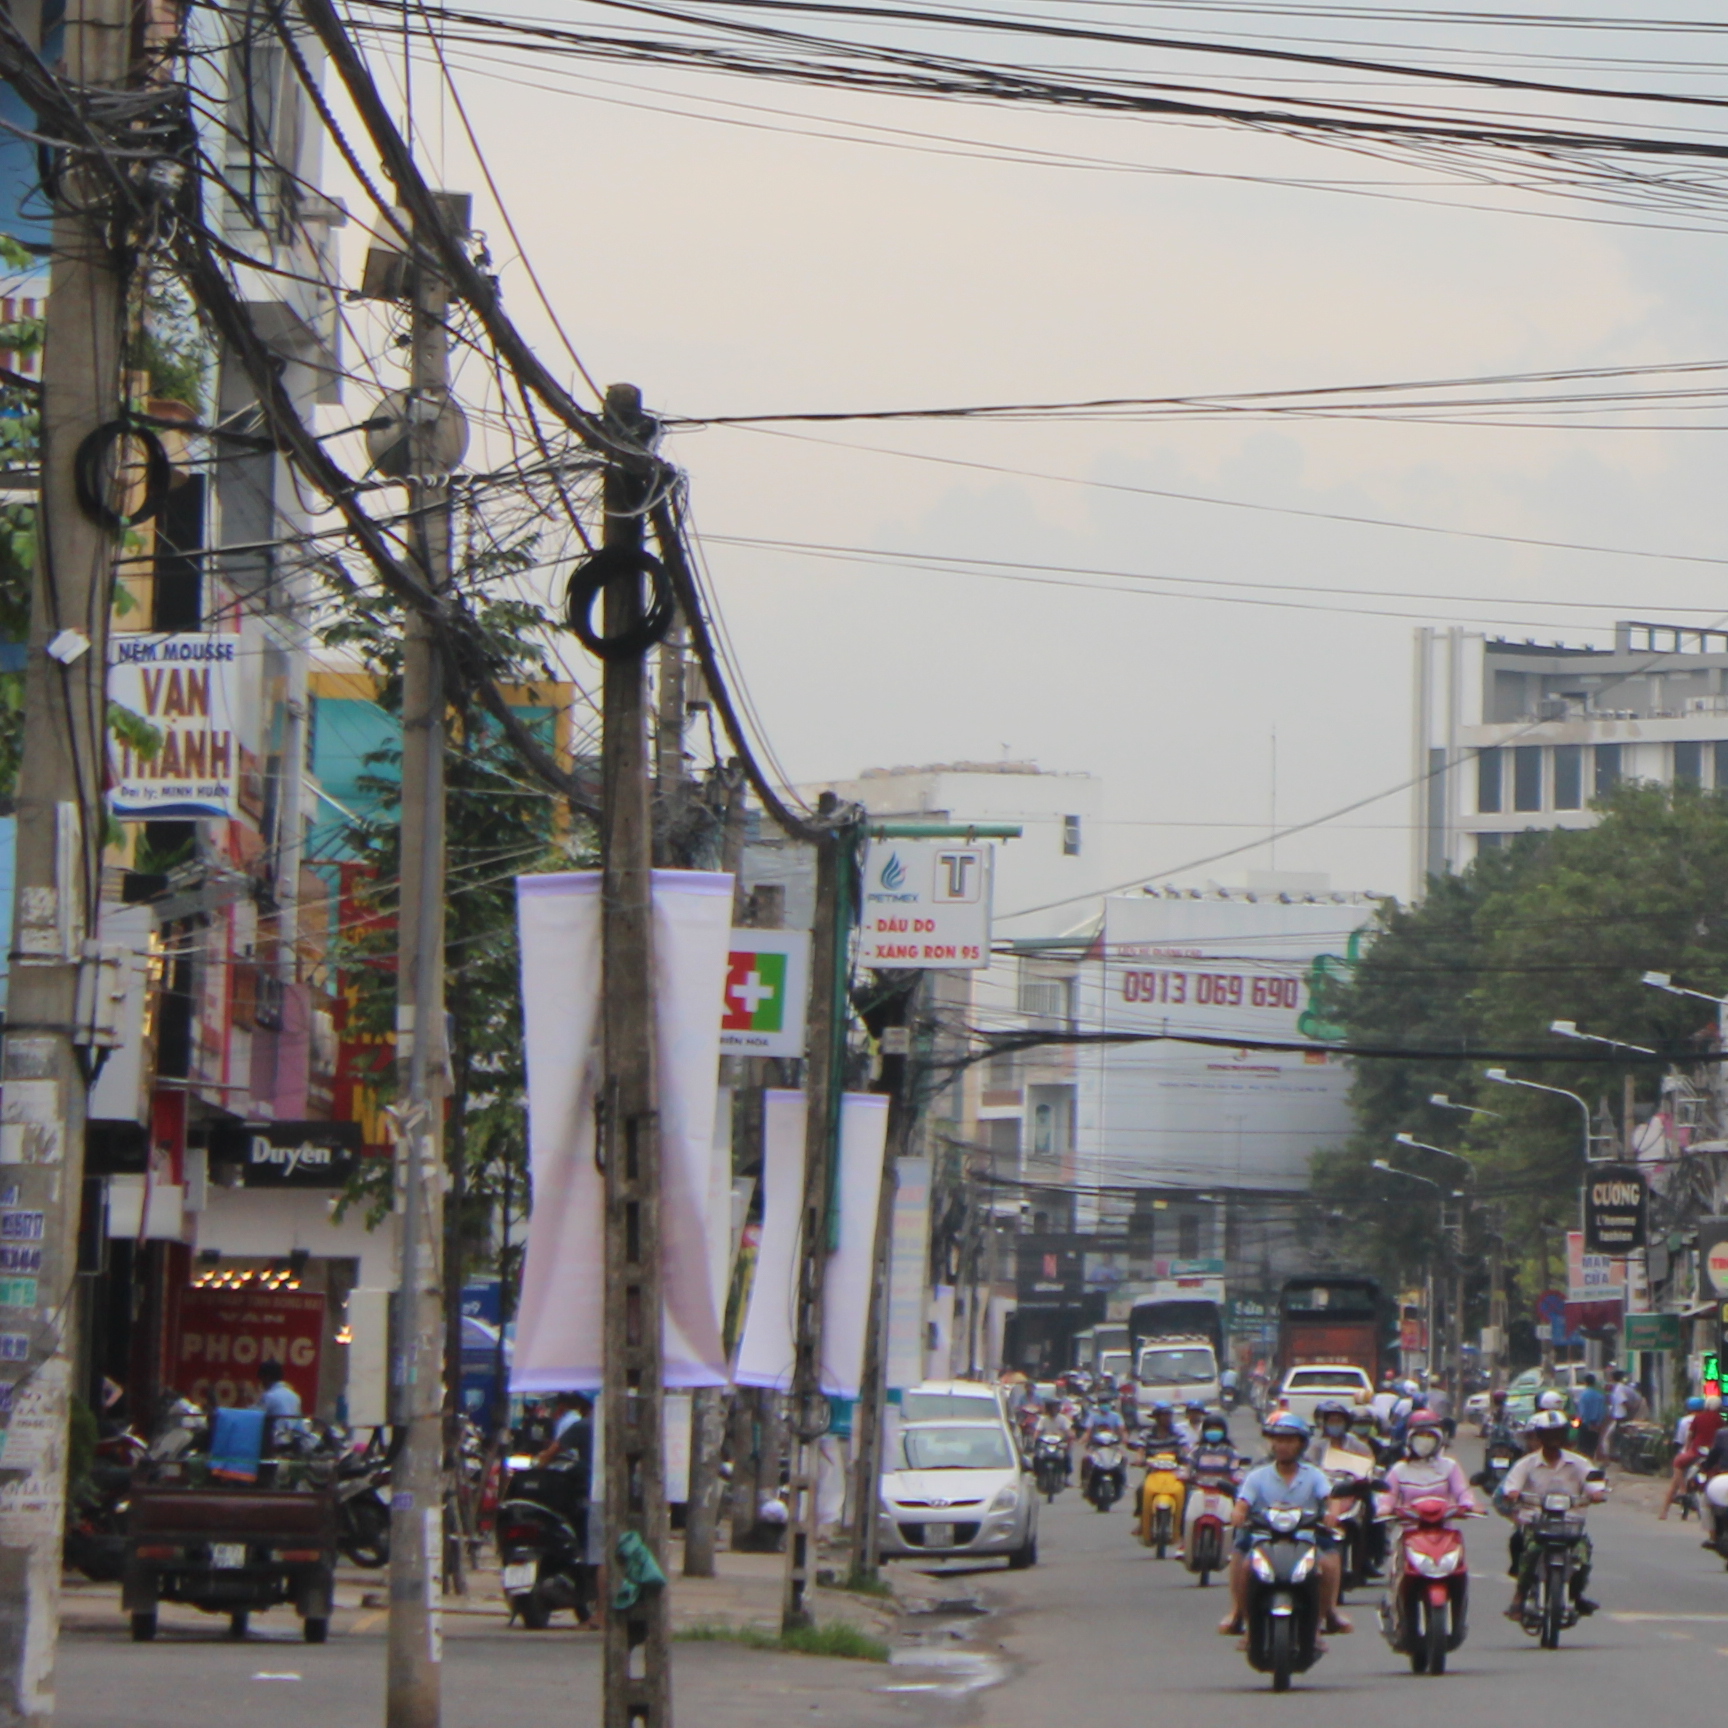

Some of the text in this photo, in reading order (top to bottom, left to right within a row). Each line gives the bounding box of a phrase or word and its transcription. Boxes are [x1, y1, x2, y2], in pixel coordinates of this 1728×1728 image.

[164, 643, 233, 662] MOUSSE
[141, 668, 211, 723] VẠN
[914, 919, 935, 933] DO
[924, 945, 956, 959] RON
[962, 945, 980, 959] 95
[1124, 971, 1299, 1009] 0913 069 690
[252, 1135, 332, 1176] Duyên
[181, 1326, 316, 1367] PHÒNG
